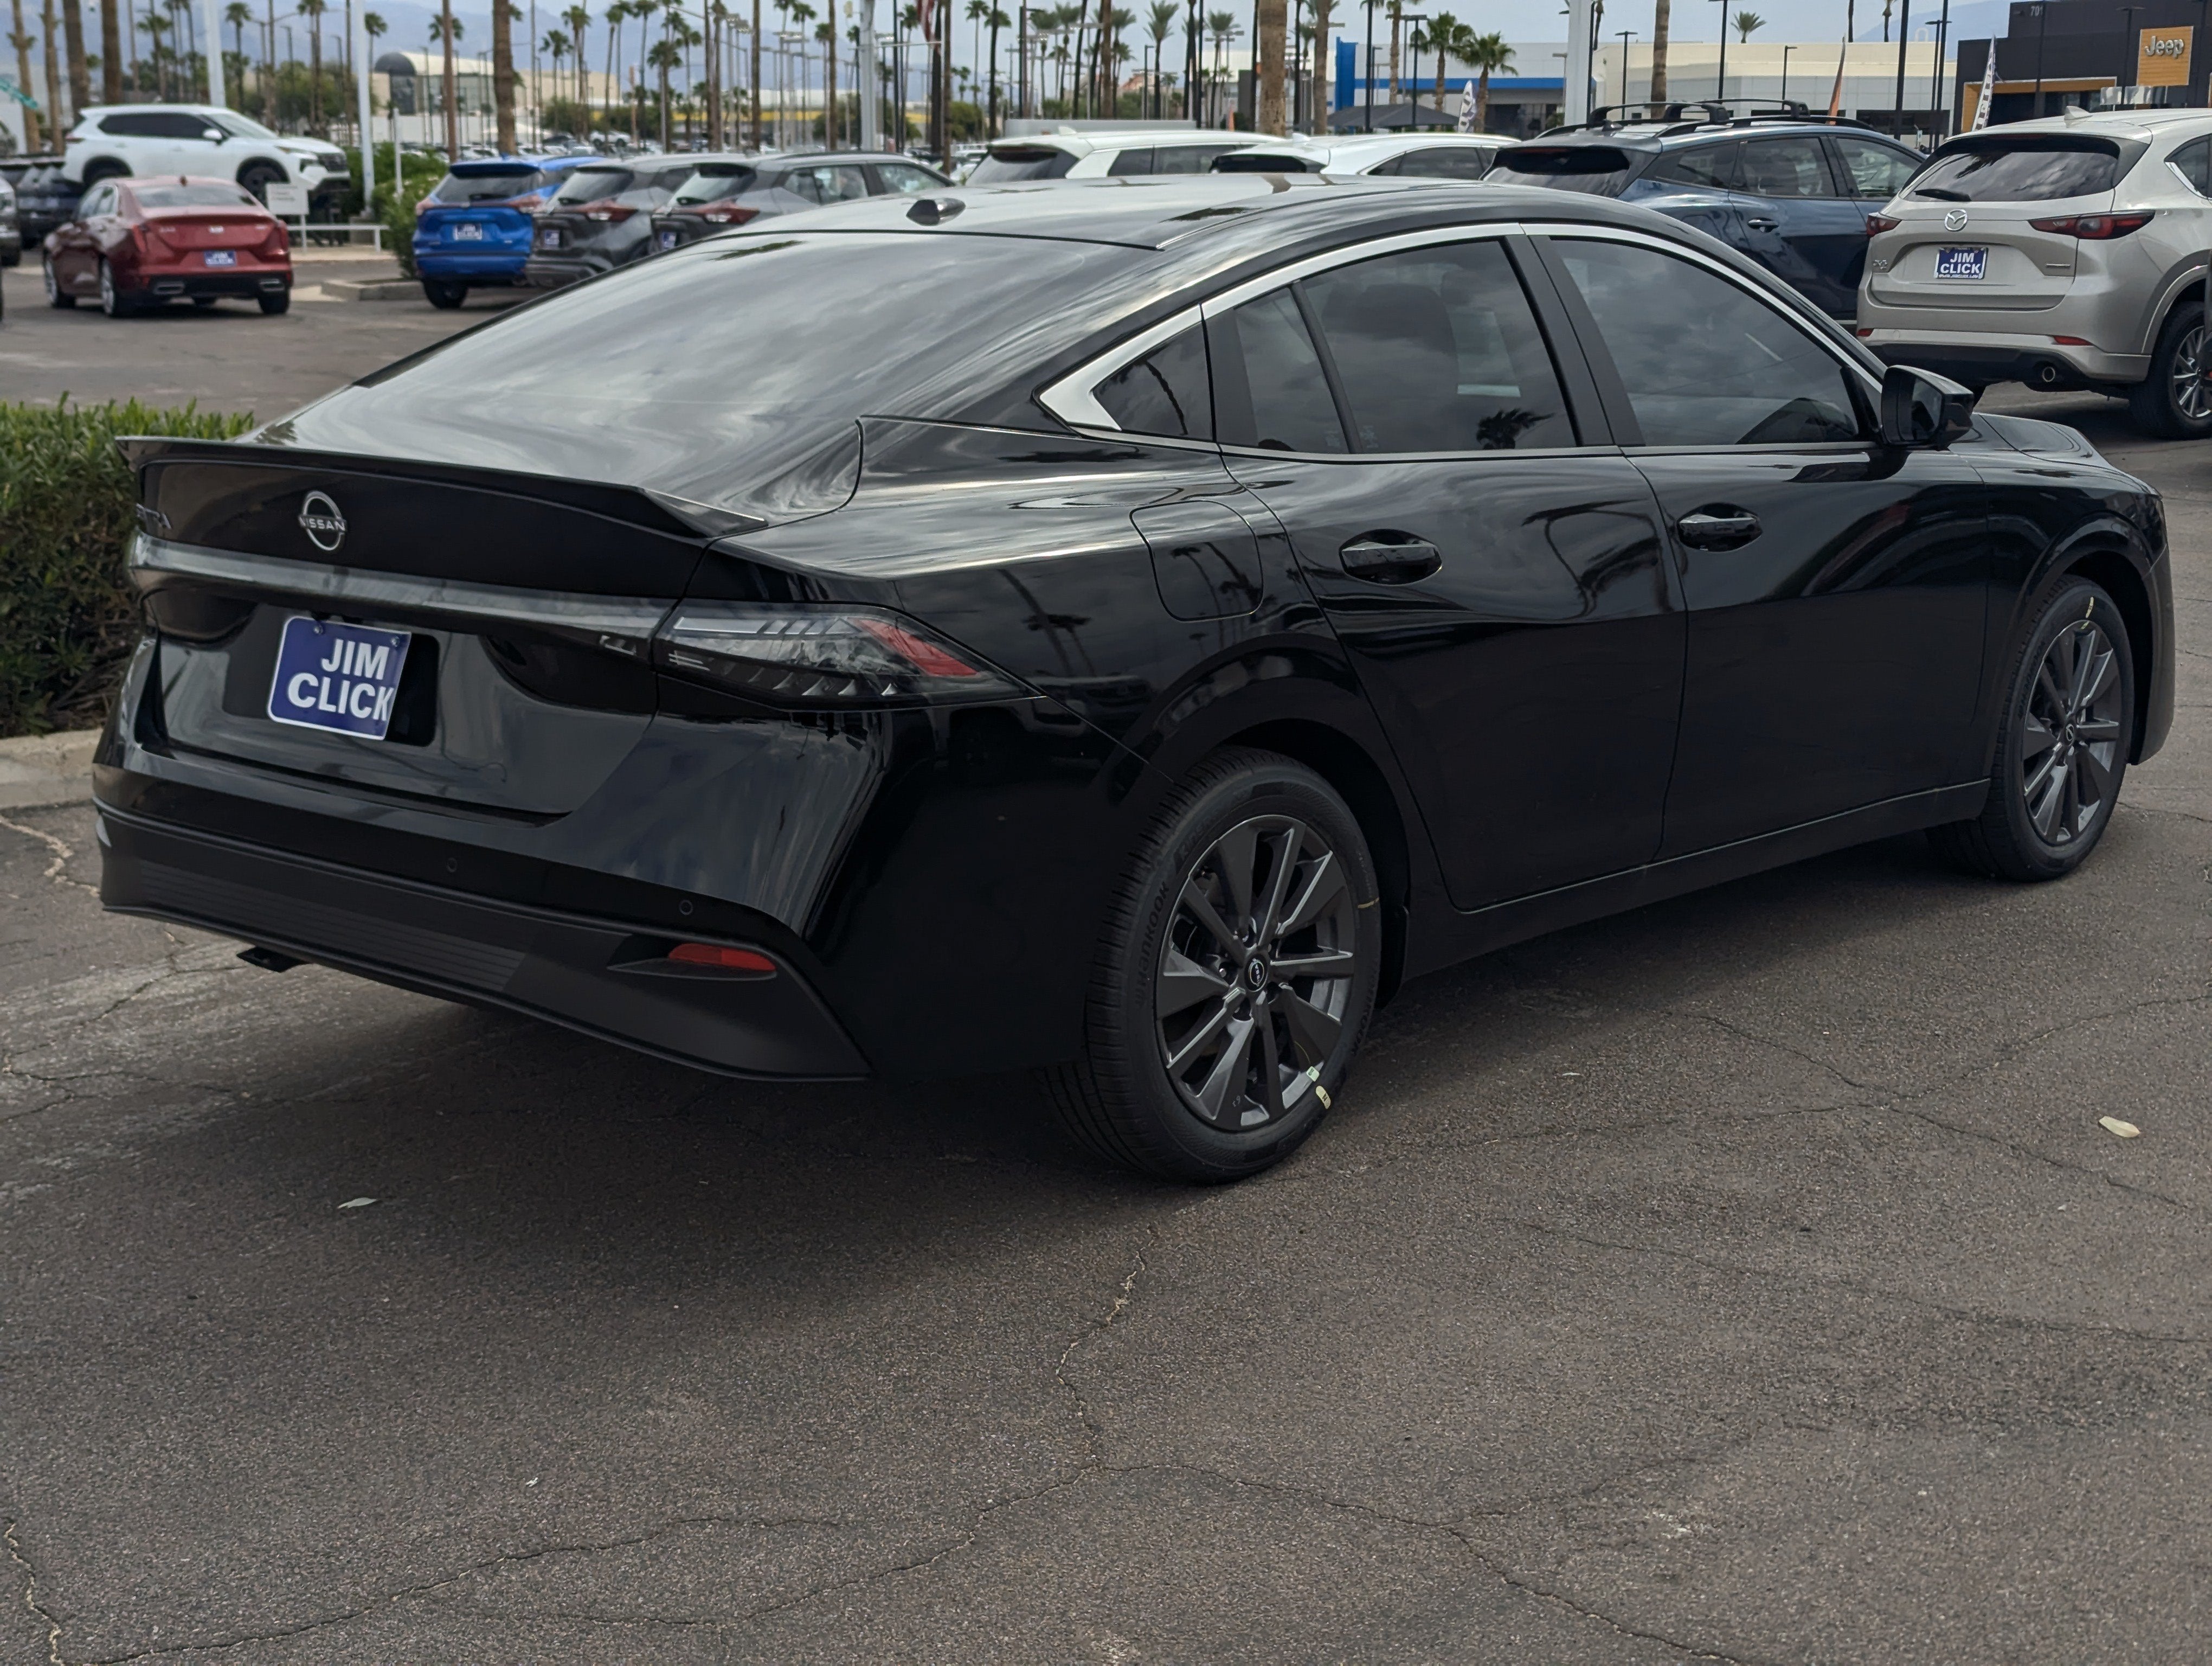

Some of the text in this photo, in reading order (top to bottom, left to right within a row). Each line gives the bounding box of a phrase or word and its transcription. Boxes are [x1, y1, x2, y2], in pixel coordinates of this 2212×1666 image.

[2145, 35, 2184, 59] Jeep
[1950, 252, 1975, 263] JIM
[1940, 263, 1981, 274] CLICK
[299, 516, 346, 531] NISSAN
[321, 638, 390, 681] JIM
[288, 672, 395, 721] CLICK
